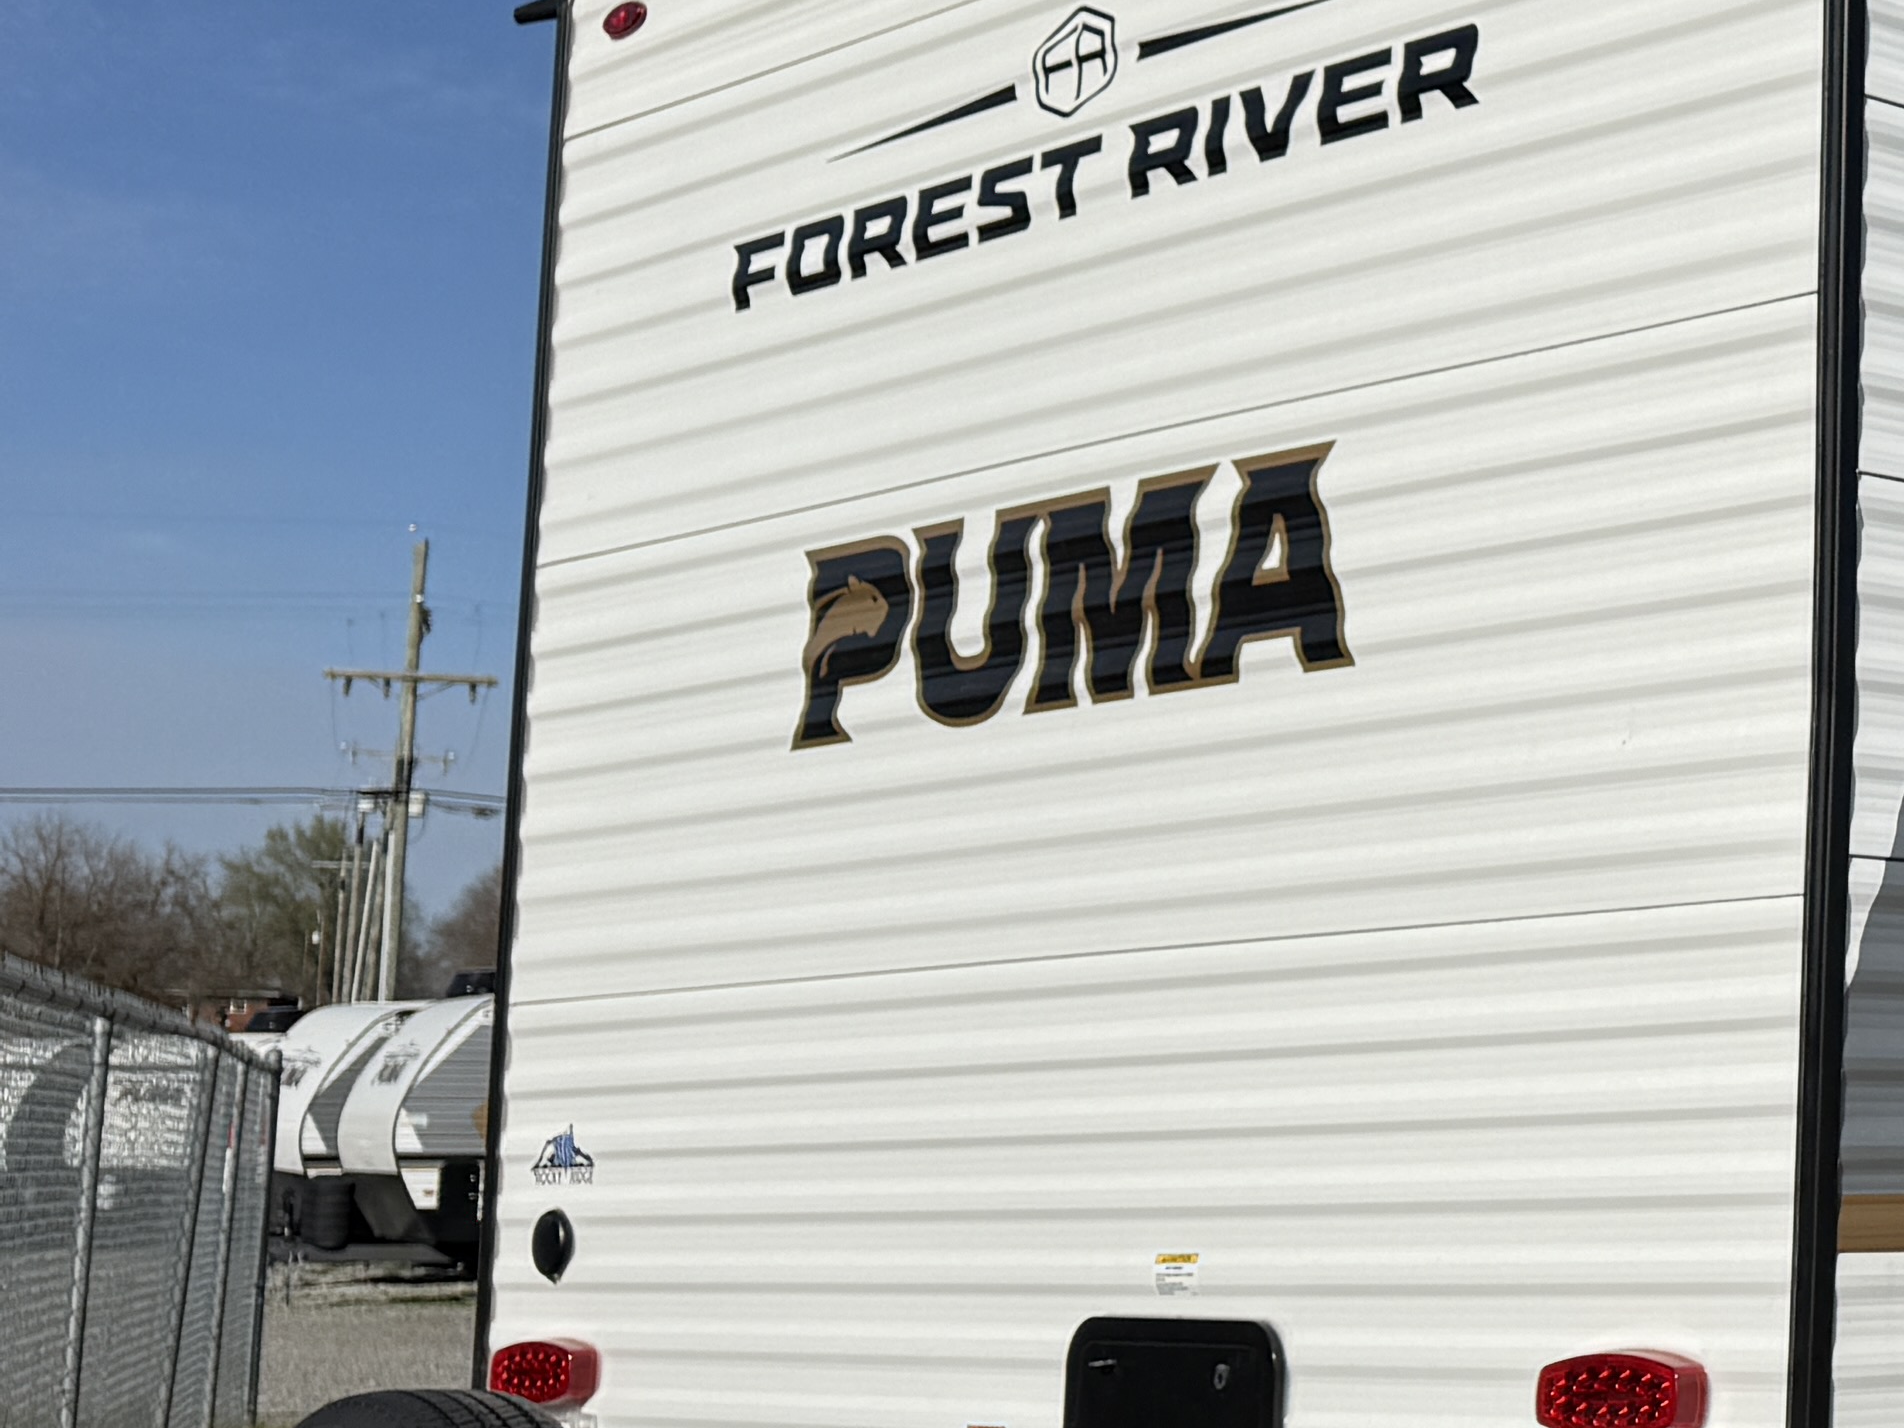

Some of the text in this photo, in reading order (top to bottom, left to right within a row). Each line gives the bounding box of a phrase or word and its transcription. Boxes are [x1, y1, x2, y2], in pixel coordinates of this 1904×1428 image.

[733, 22, 1481, 313] FOREST RIVER
[790, 439, 1355, 751] PUMA
